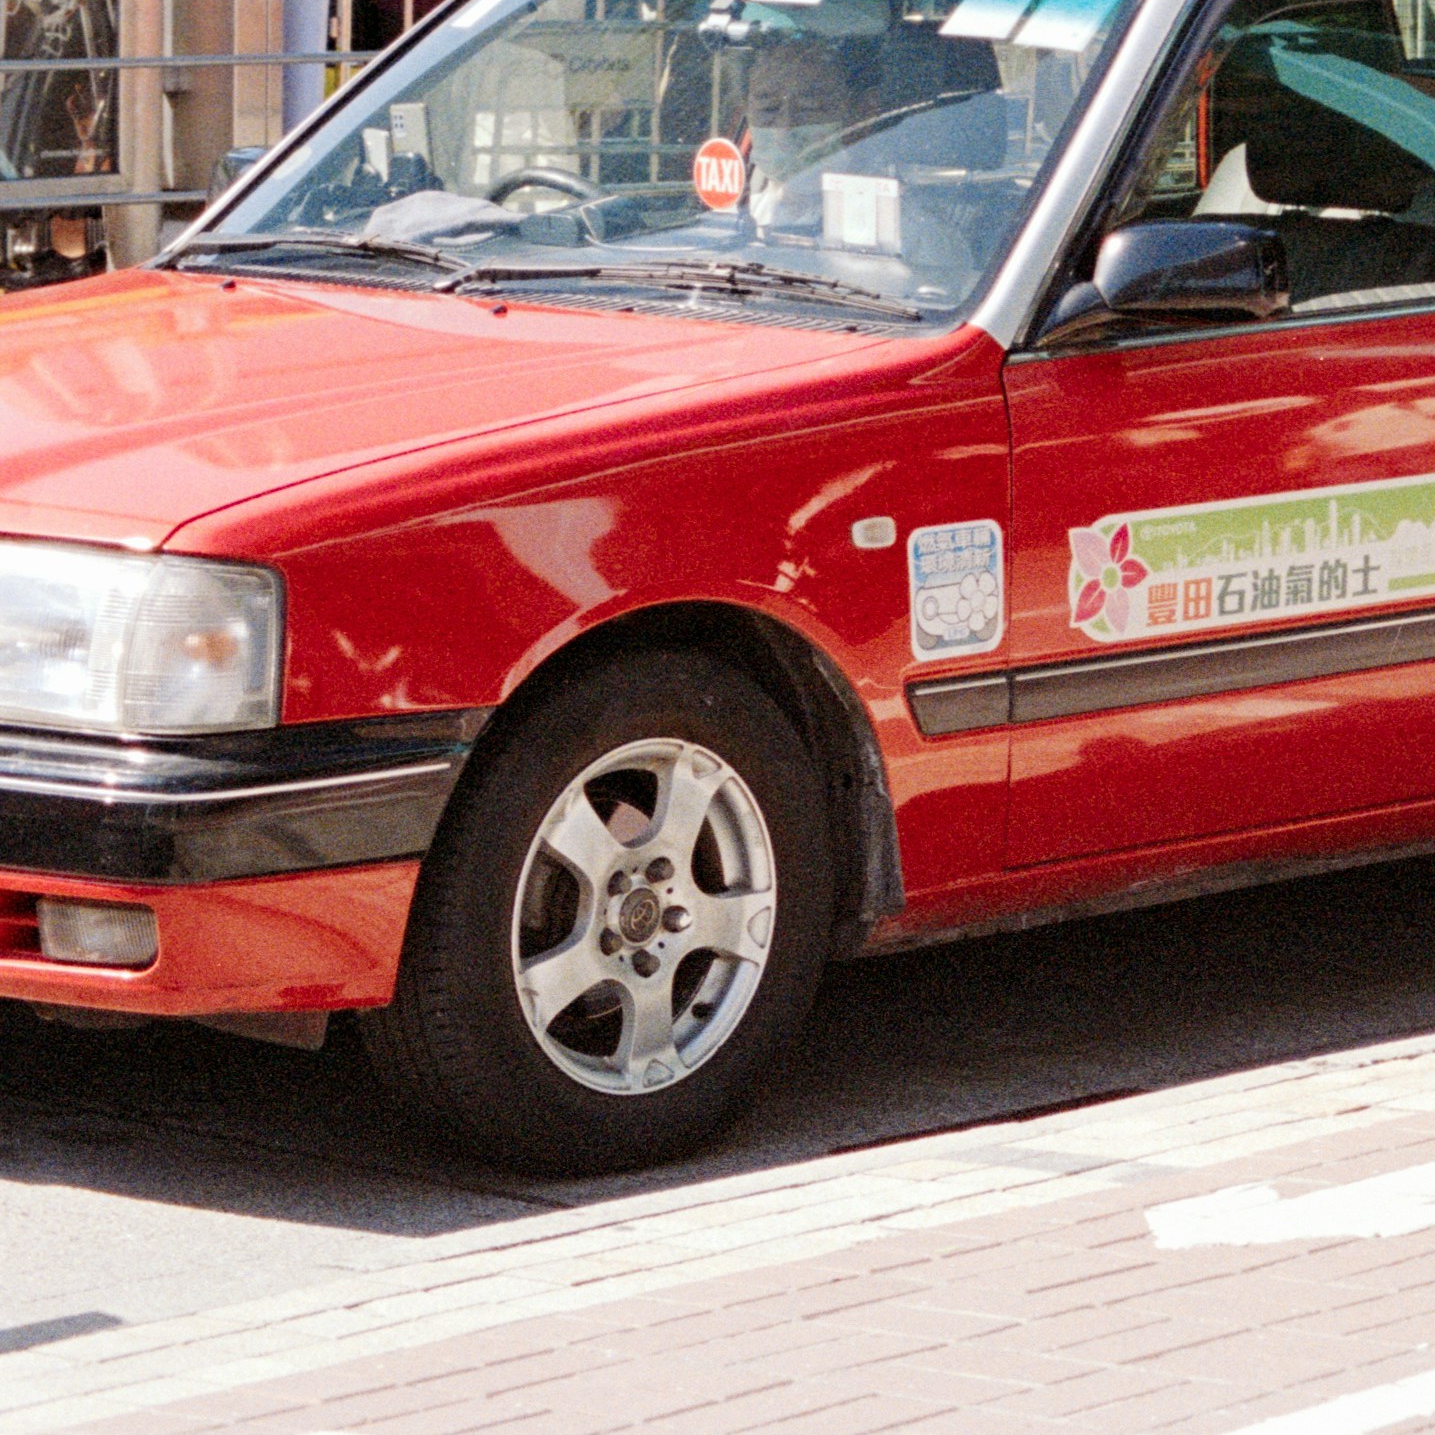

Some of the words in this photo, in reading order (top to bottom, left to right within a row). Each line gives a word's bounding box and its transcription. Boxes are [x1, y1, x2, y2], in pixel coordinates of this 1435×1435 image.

[698, 155, 739, 194] TAXI
[1145, 554, 1382, 627] 豐田石油氣的士
